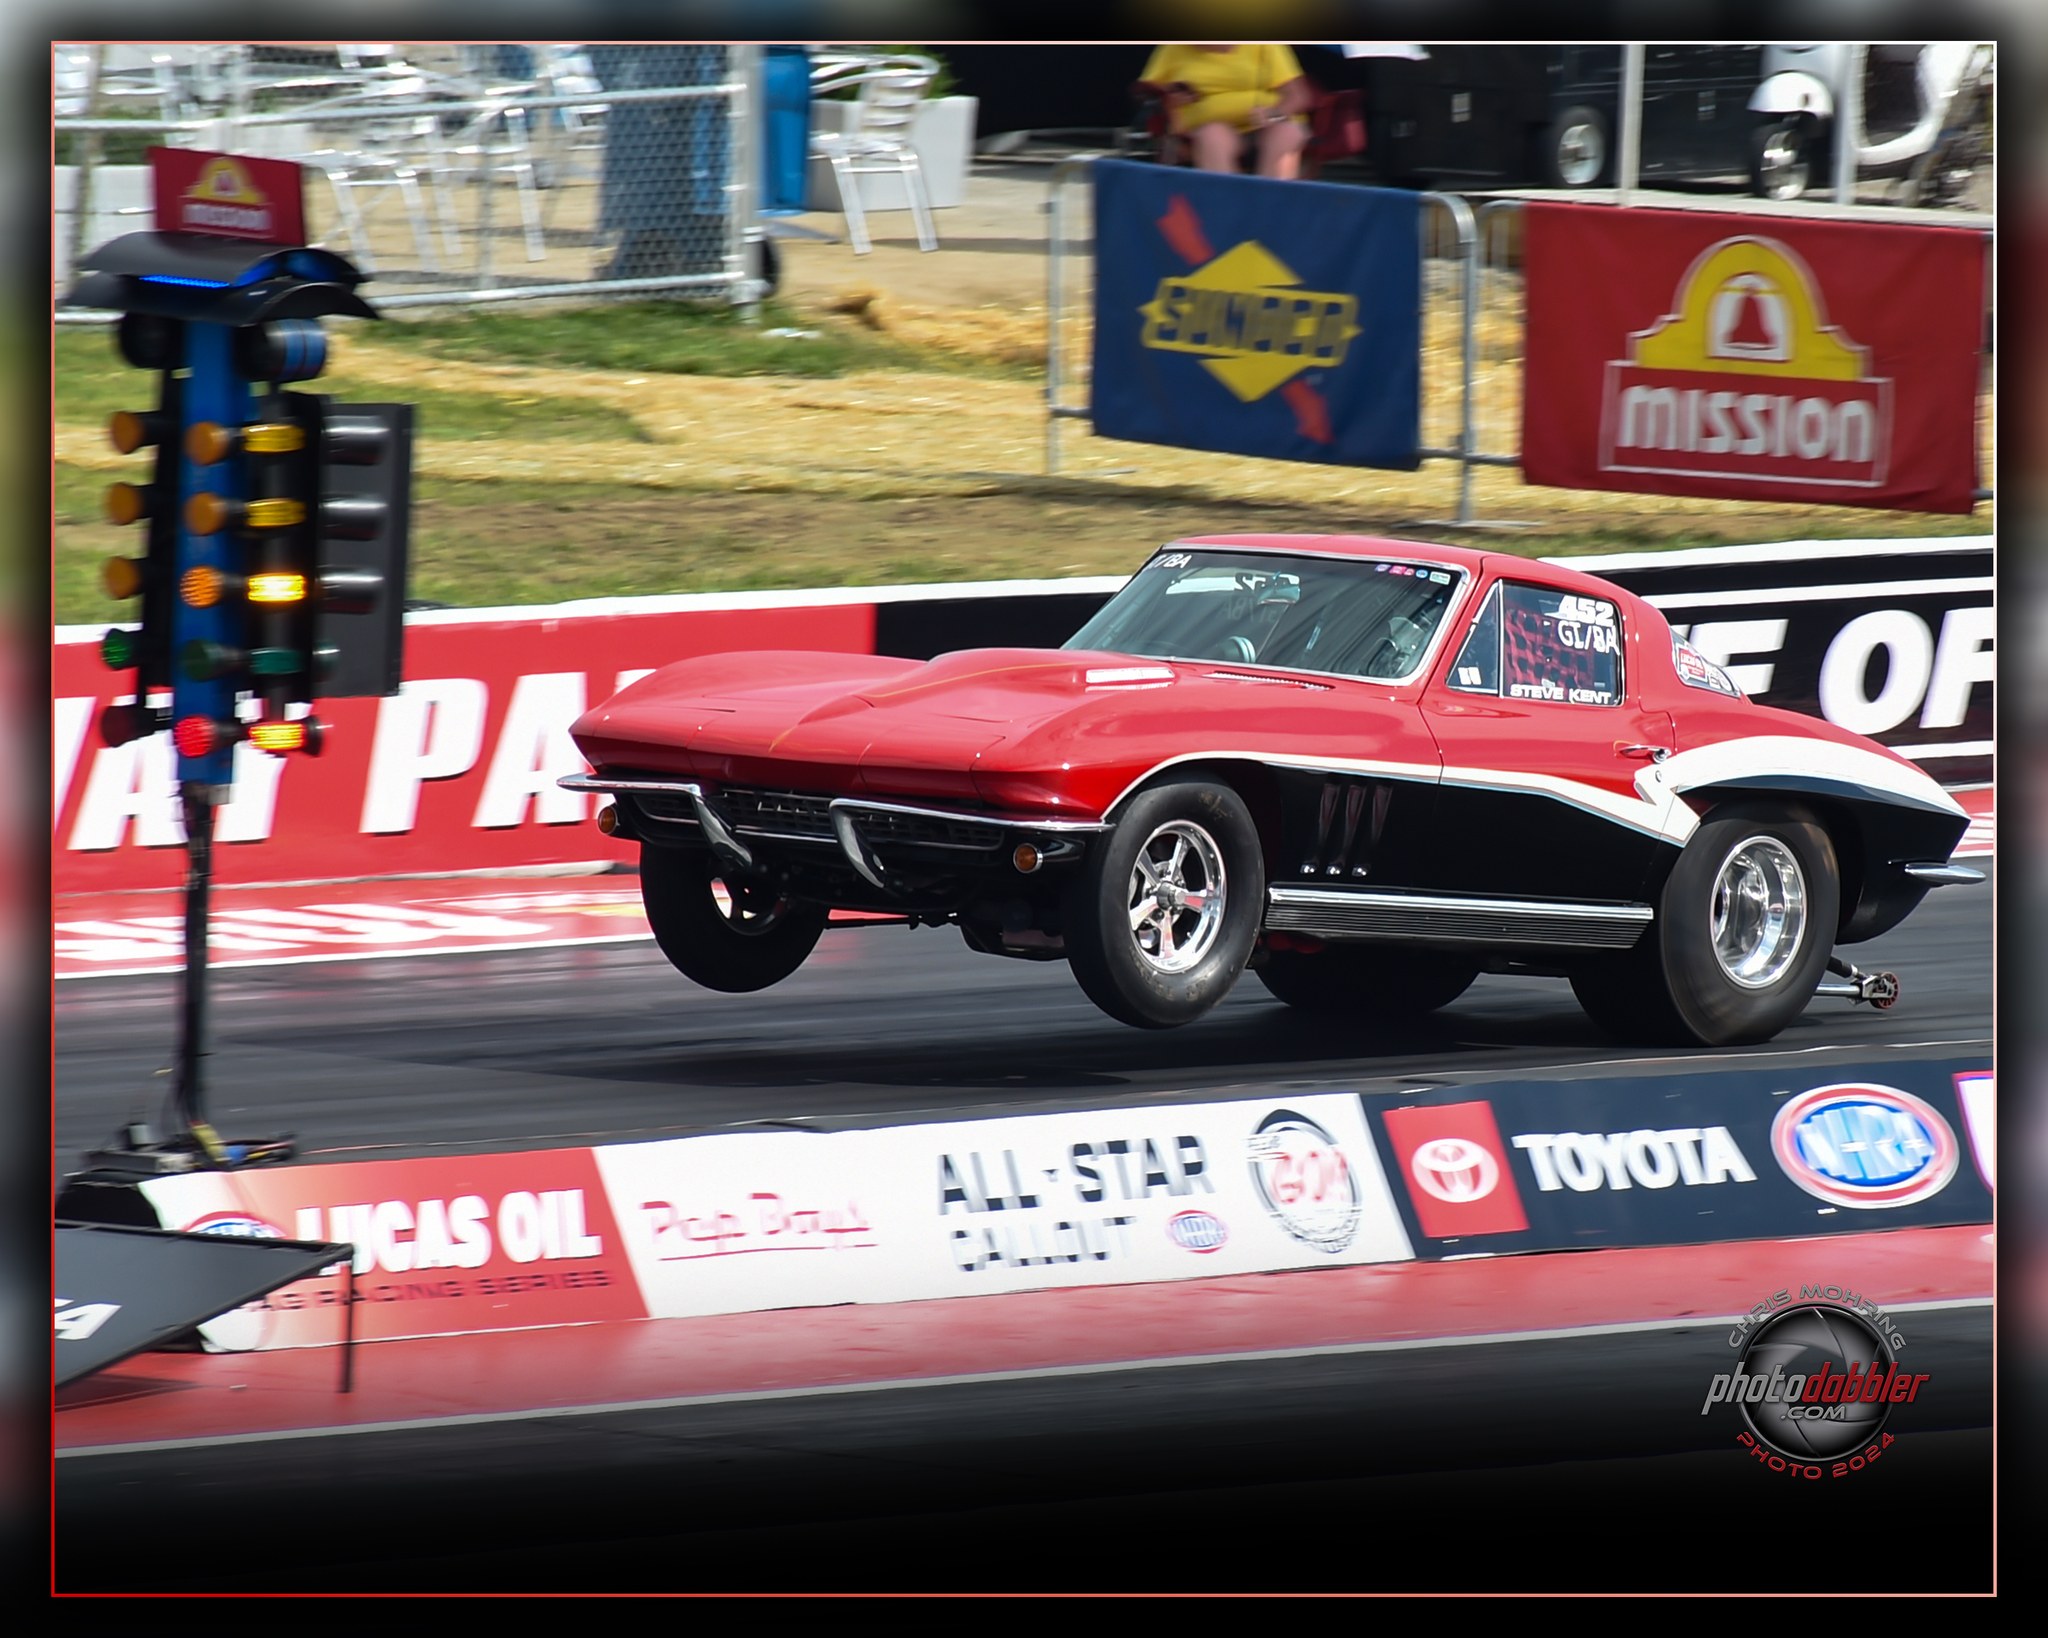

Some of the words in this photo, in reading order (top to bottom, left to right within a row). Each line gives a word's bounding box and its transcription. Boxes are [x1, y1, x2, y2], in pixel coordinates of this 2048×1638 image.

[1154, 284, 1349, 359] SUNOCO
[1557, 620, 1621, 656] GI/BA
[1558, 595, 1615, 627] 452
[1510, 684, 1564, 700] STEVE
[1569, 688, 1612, 704] KENT
[938, 1149, 1042, 1216] ALL
[1069, 1135, 1217, 1204] STAR
[1512, 1125, 1758, 1192] TOYOTA
[296, 1194, 492, 1275] LUCAS
[498, 1188, 603, 1264] OIL
[951, 1214, 1138, 1272] CALLOUT
[476, 1270, 616, 1296] SERIES
